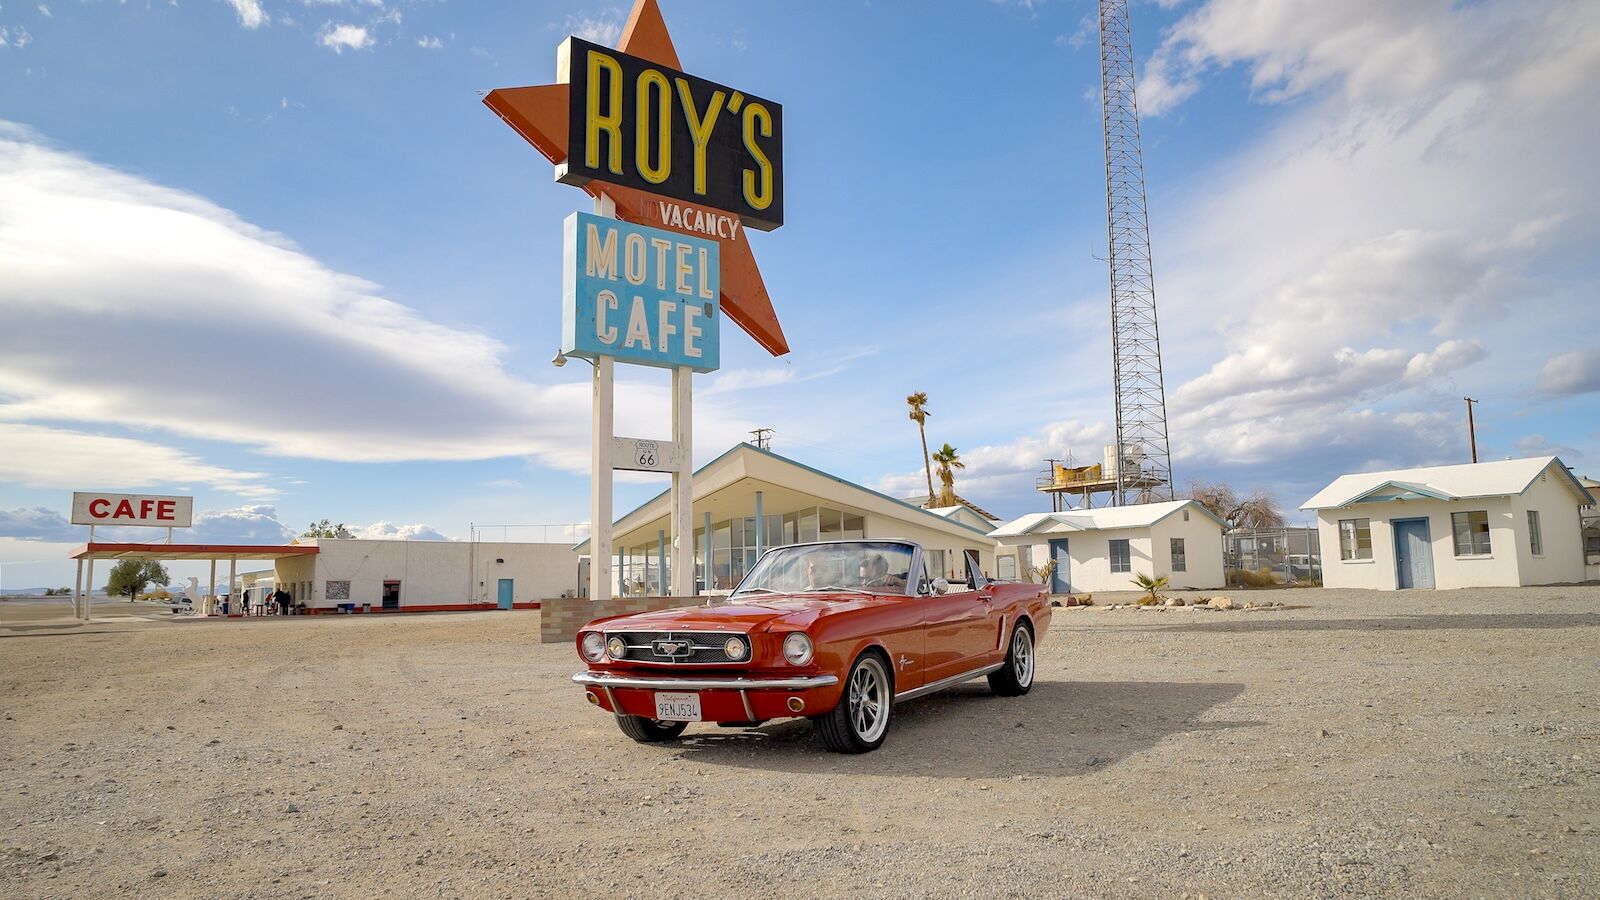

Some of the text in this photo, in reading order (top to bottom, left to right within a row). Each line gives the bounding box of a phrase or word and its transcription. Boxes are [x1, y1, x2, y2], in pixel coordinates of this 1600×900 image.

[585, 49, 774, 211] ROY'S
[659, 201, 740, 241] VACANCY
[586, 223, 714, 300] MOTEL
[596, 289, 702, 358] CAFE
[640, 454, 654, 465] 66
[89, 498, 176, 520] CAFE
[659, 703, 697, 717] 9ENJ534
